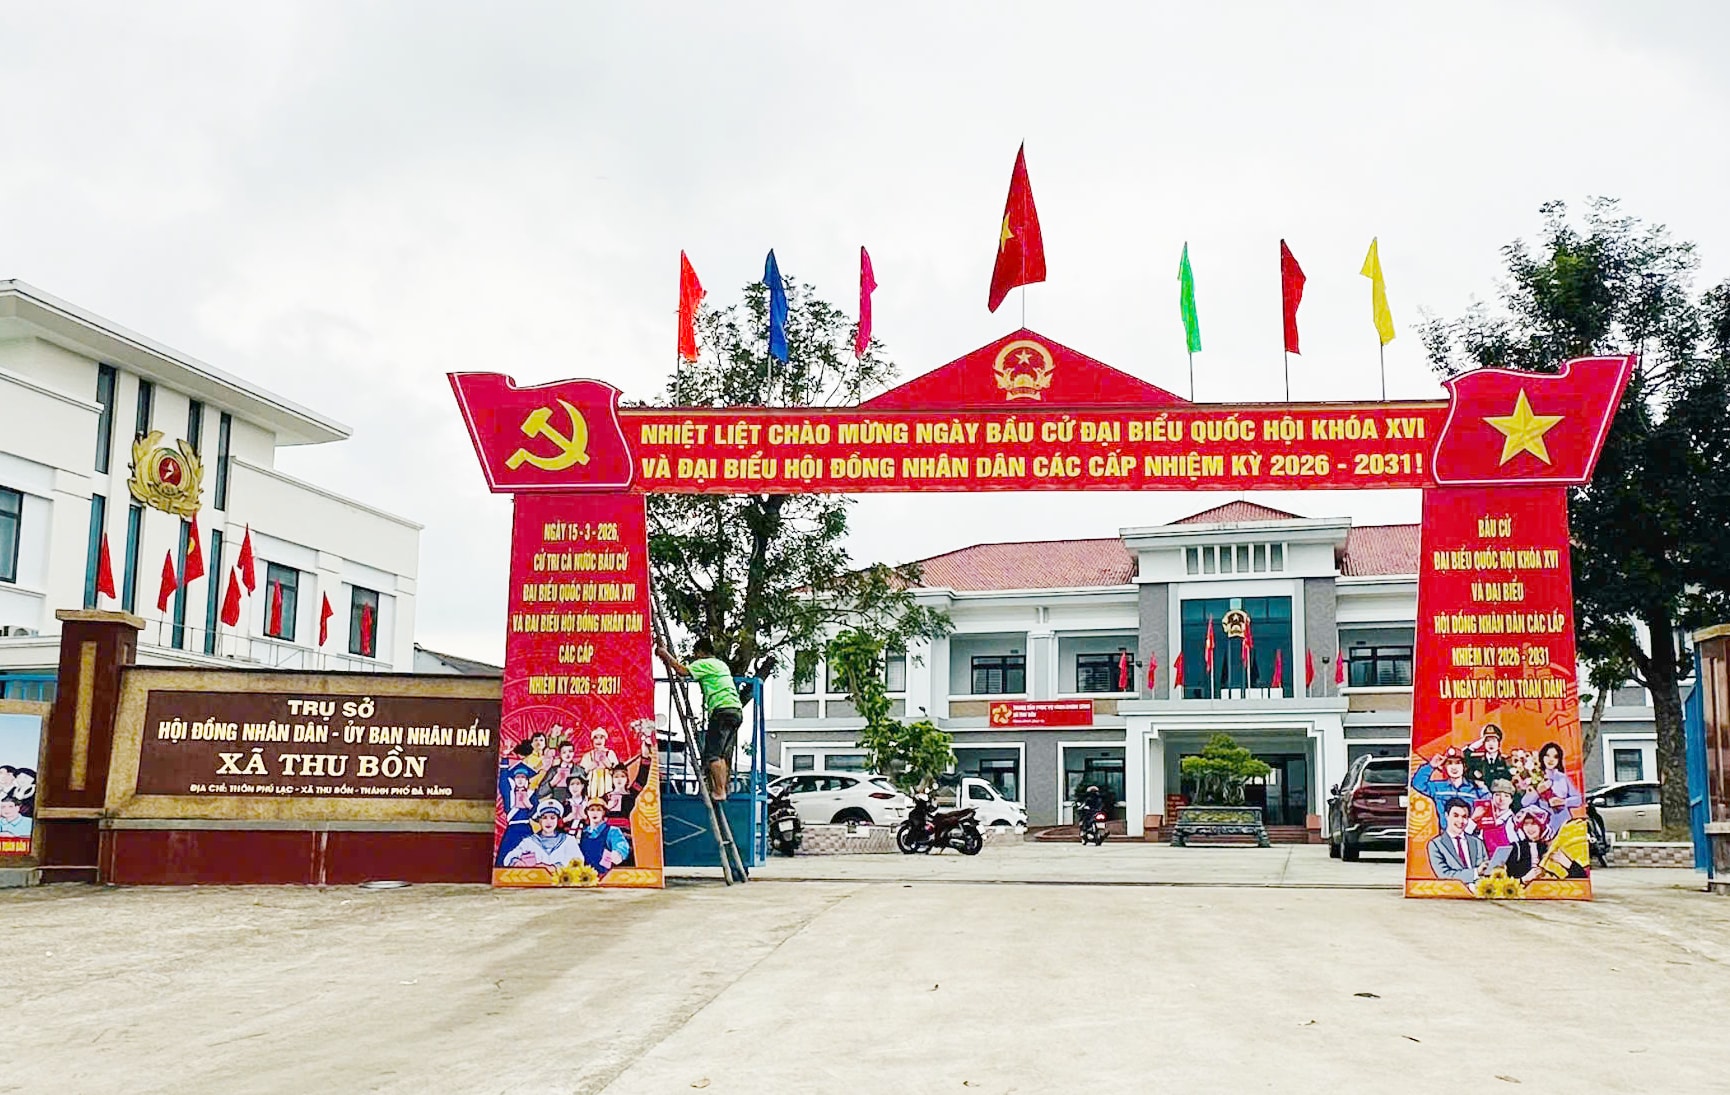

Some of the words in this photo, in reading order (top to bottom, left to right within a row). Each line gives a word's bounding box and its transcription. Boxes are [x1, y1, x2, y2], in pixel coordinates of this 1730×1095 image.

[640, 420, 708, 449] NHIỆT
[714, 420, 761, 449] LIỆT
[768, 419, 830, 445] CHÀO
[838, 418, 908, 444] MỪNG
[917, 417, 978, 444] NGÀY
[985, 415, 1033, 444] BẦU
[1042, 414, 1077, 441] CỬ
[1080, 418, 1120, 447] ĐẠI
[1129, 413, 1183, 442] BIỂU
[1190, 413, 1255, 443] QUỐC
[1263, 416, 1304, 445] HỘI
[1312, 413, 1378, 440] KHÓA
[1385, 418, 1425, 439] XVI
[641, 453, 671, 479] VÀ
[678, 457, 716, 483] ĐẠI
[725, 451, 777, 480] BIỂU
[784, 454, 823, 483] HỘI
[830, 451, 895, 479] ĐỒNG
[902, 453, 969, 478] NHÂN
[976, 452, 1026, 478] DÂN
[1033, 451, 1081, 477] CÁC
[1088, 449, 1137, 476] CẤP
[1144, 451, 1224, 481] NHIỆM
[1231, 451, 1263, 476] KỲ
[1270, 454, 1330, 476] 2026
[1354, 453, 1423, 475] 2031!
[567, 523, 578, 541] 15
[1497, 647, 1520, 666] 2026
[1528, 647, 1549, 666] 2031
[569, 676, 591, 695] 2026
[287, 699, 335, 721] TRỤ
[342, 697, 375, 719] SỞ
[158, 718, 188, 744] HỘI
[191, 717, 238, 741] ĐỒNG
[242, 720, 290, 742] NHÂN
[293, 721, 328, 743] DÂN
[343, 720, 366, 744] ỦY
[369, 726, 403, 745] BAN
[407, 725, 453, 746] NHÂN
[215, 747, 269, 775] XÃ
[278, 752, 349, 777] THU
[356, 745, 428, 778] BỒN
